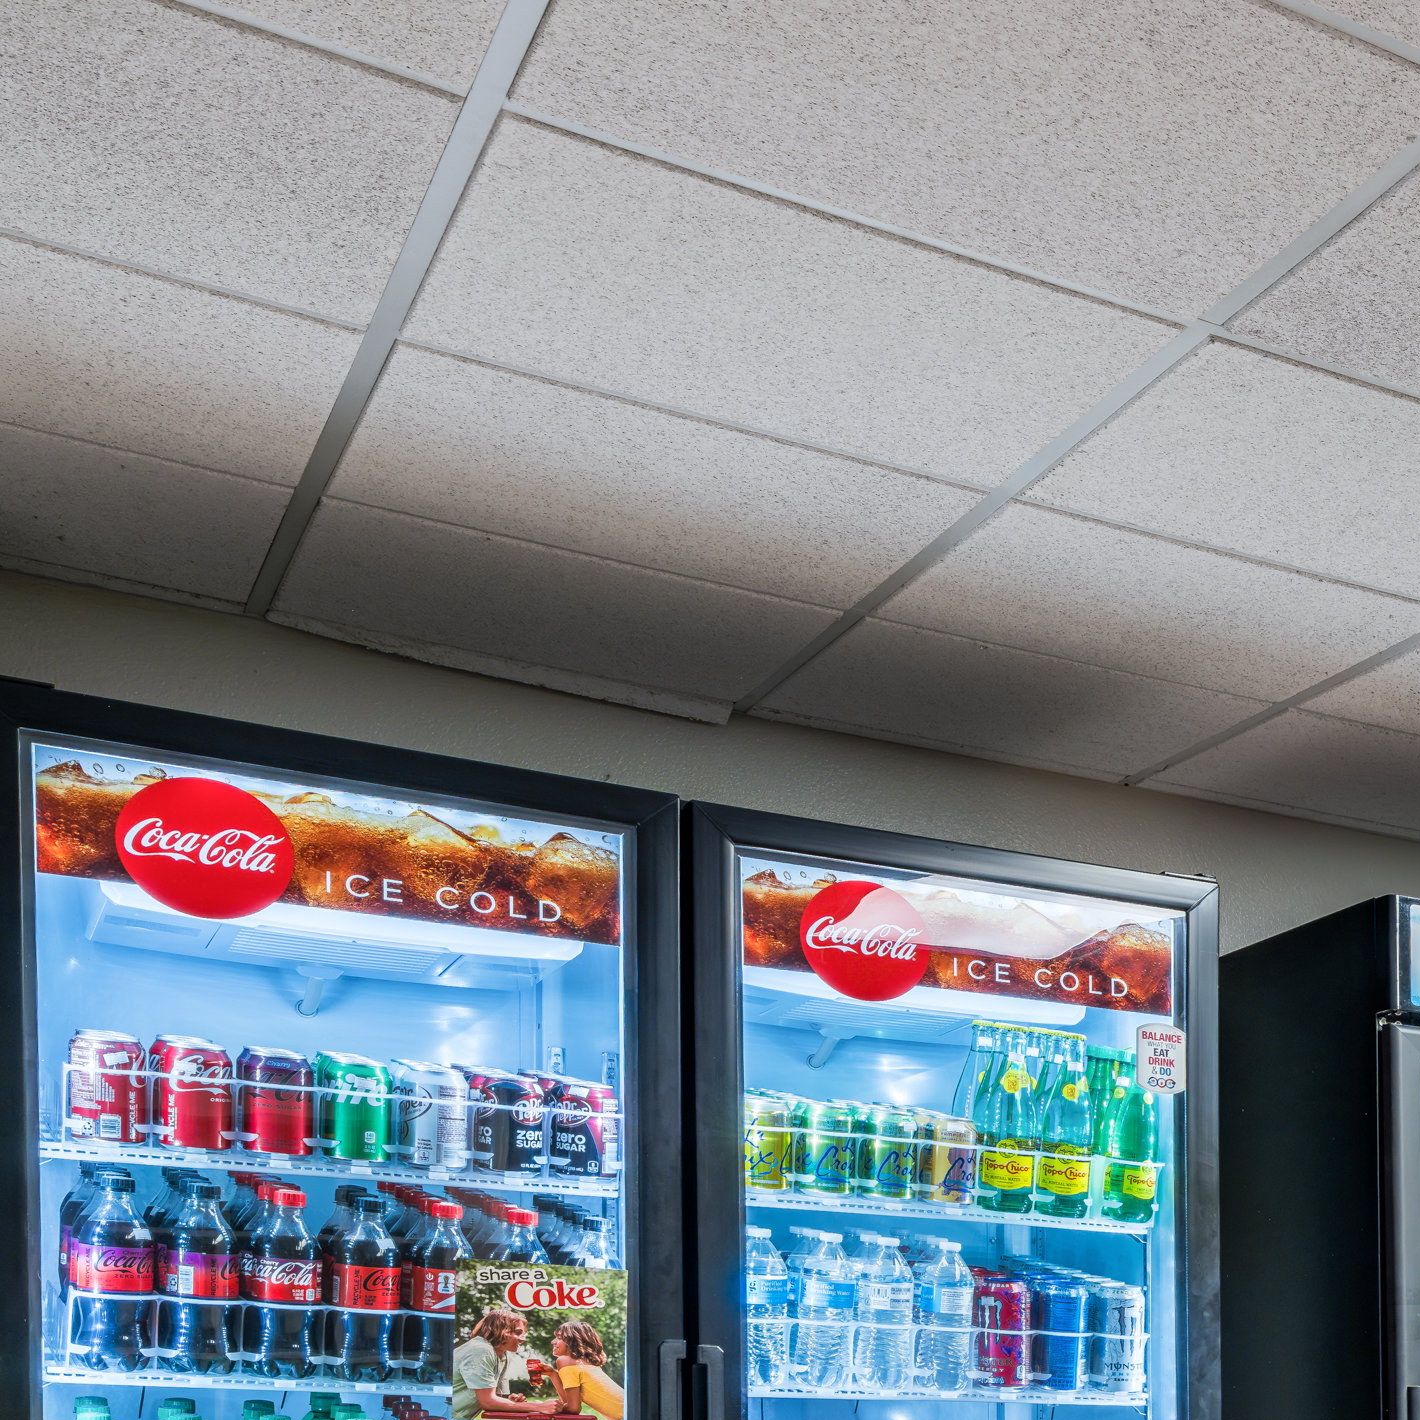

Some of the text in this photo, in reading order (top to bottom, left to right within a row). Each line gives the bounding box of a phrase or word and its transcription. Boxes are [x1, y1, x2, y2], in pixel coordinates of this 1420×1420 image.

[122, 816, 277, 875] Coca-Cola
[324, 869, 563, 923] ICE COLD
[805, 915, 922, 962] Coca-Cola
[952, 960, 1128, 998] ICE COLD
[1141, 1031, 1182, 1044] BALANCE
[1153, 1048, 1169, 1058] EAT
[1148, 1057, 1175, 1068] DRINK
[1152, 1066, 1172, 1076] & DO
[1005, 1159, 1031, 1175] Chico
[1062, 1164, 1088, 1180] Chico
[479, 1268, 545, 1281] share a
[507, 1281, 599, 1309] Coke
